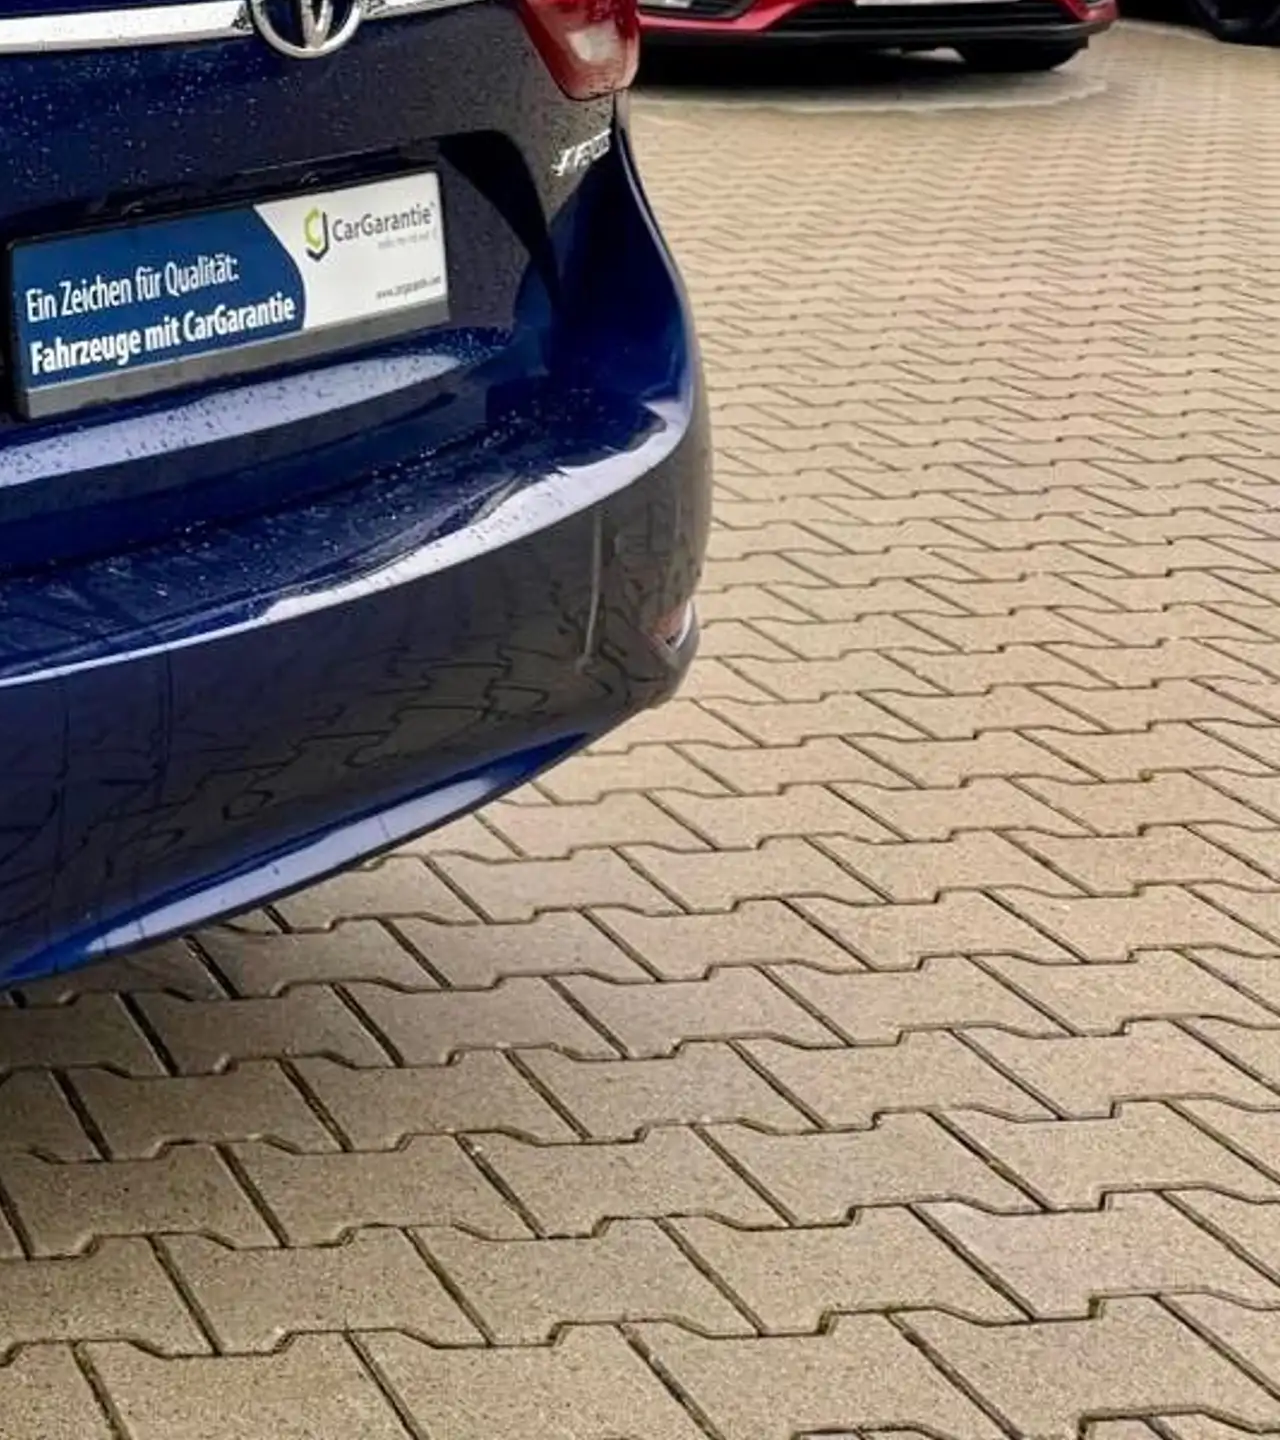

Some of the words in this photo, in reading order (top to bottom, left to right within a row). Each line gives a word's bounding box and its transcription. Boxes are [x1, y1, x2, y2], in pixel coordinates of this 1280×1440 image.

[331, 203, 432, 242] CarGarantie
[26, 288, 57, 323] Ein
[59, 274, 132, 316] Zeichen
[135, 265, 162, 301] für
[164, 252, 240, 297] Qualität:
[29, 335, 141, 376] Fahrzeuge
[144, 315, 180, 351] mit
[183, 291, 296, 342] CarGarantie
